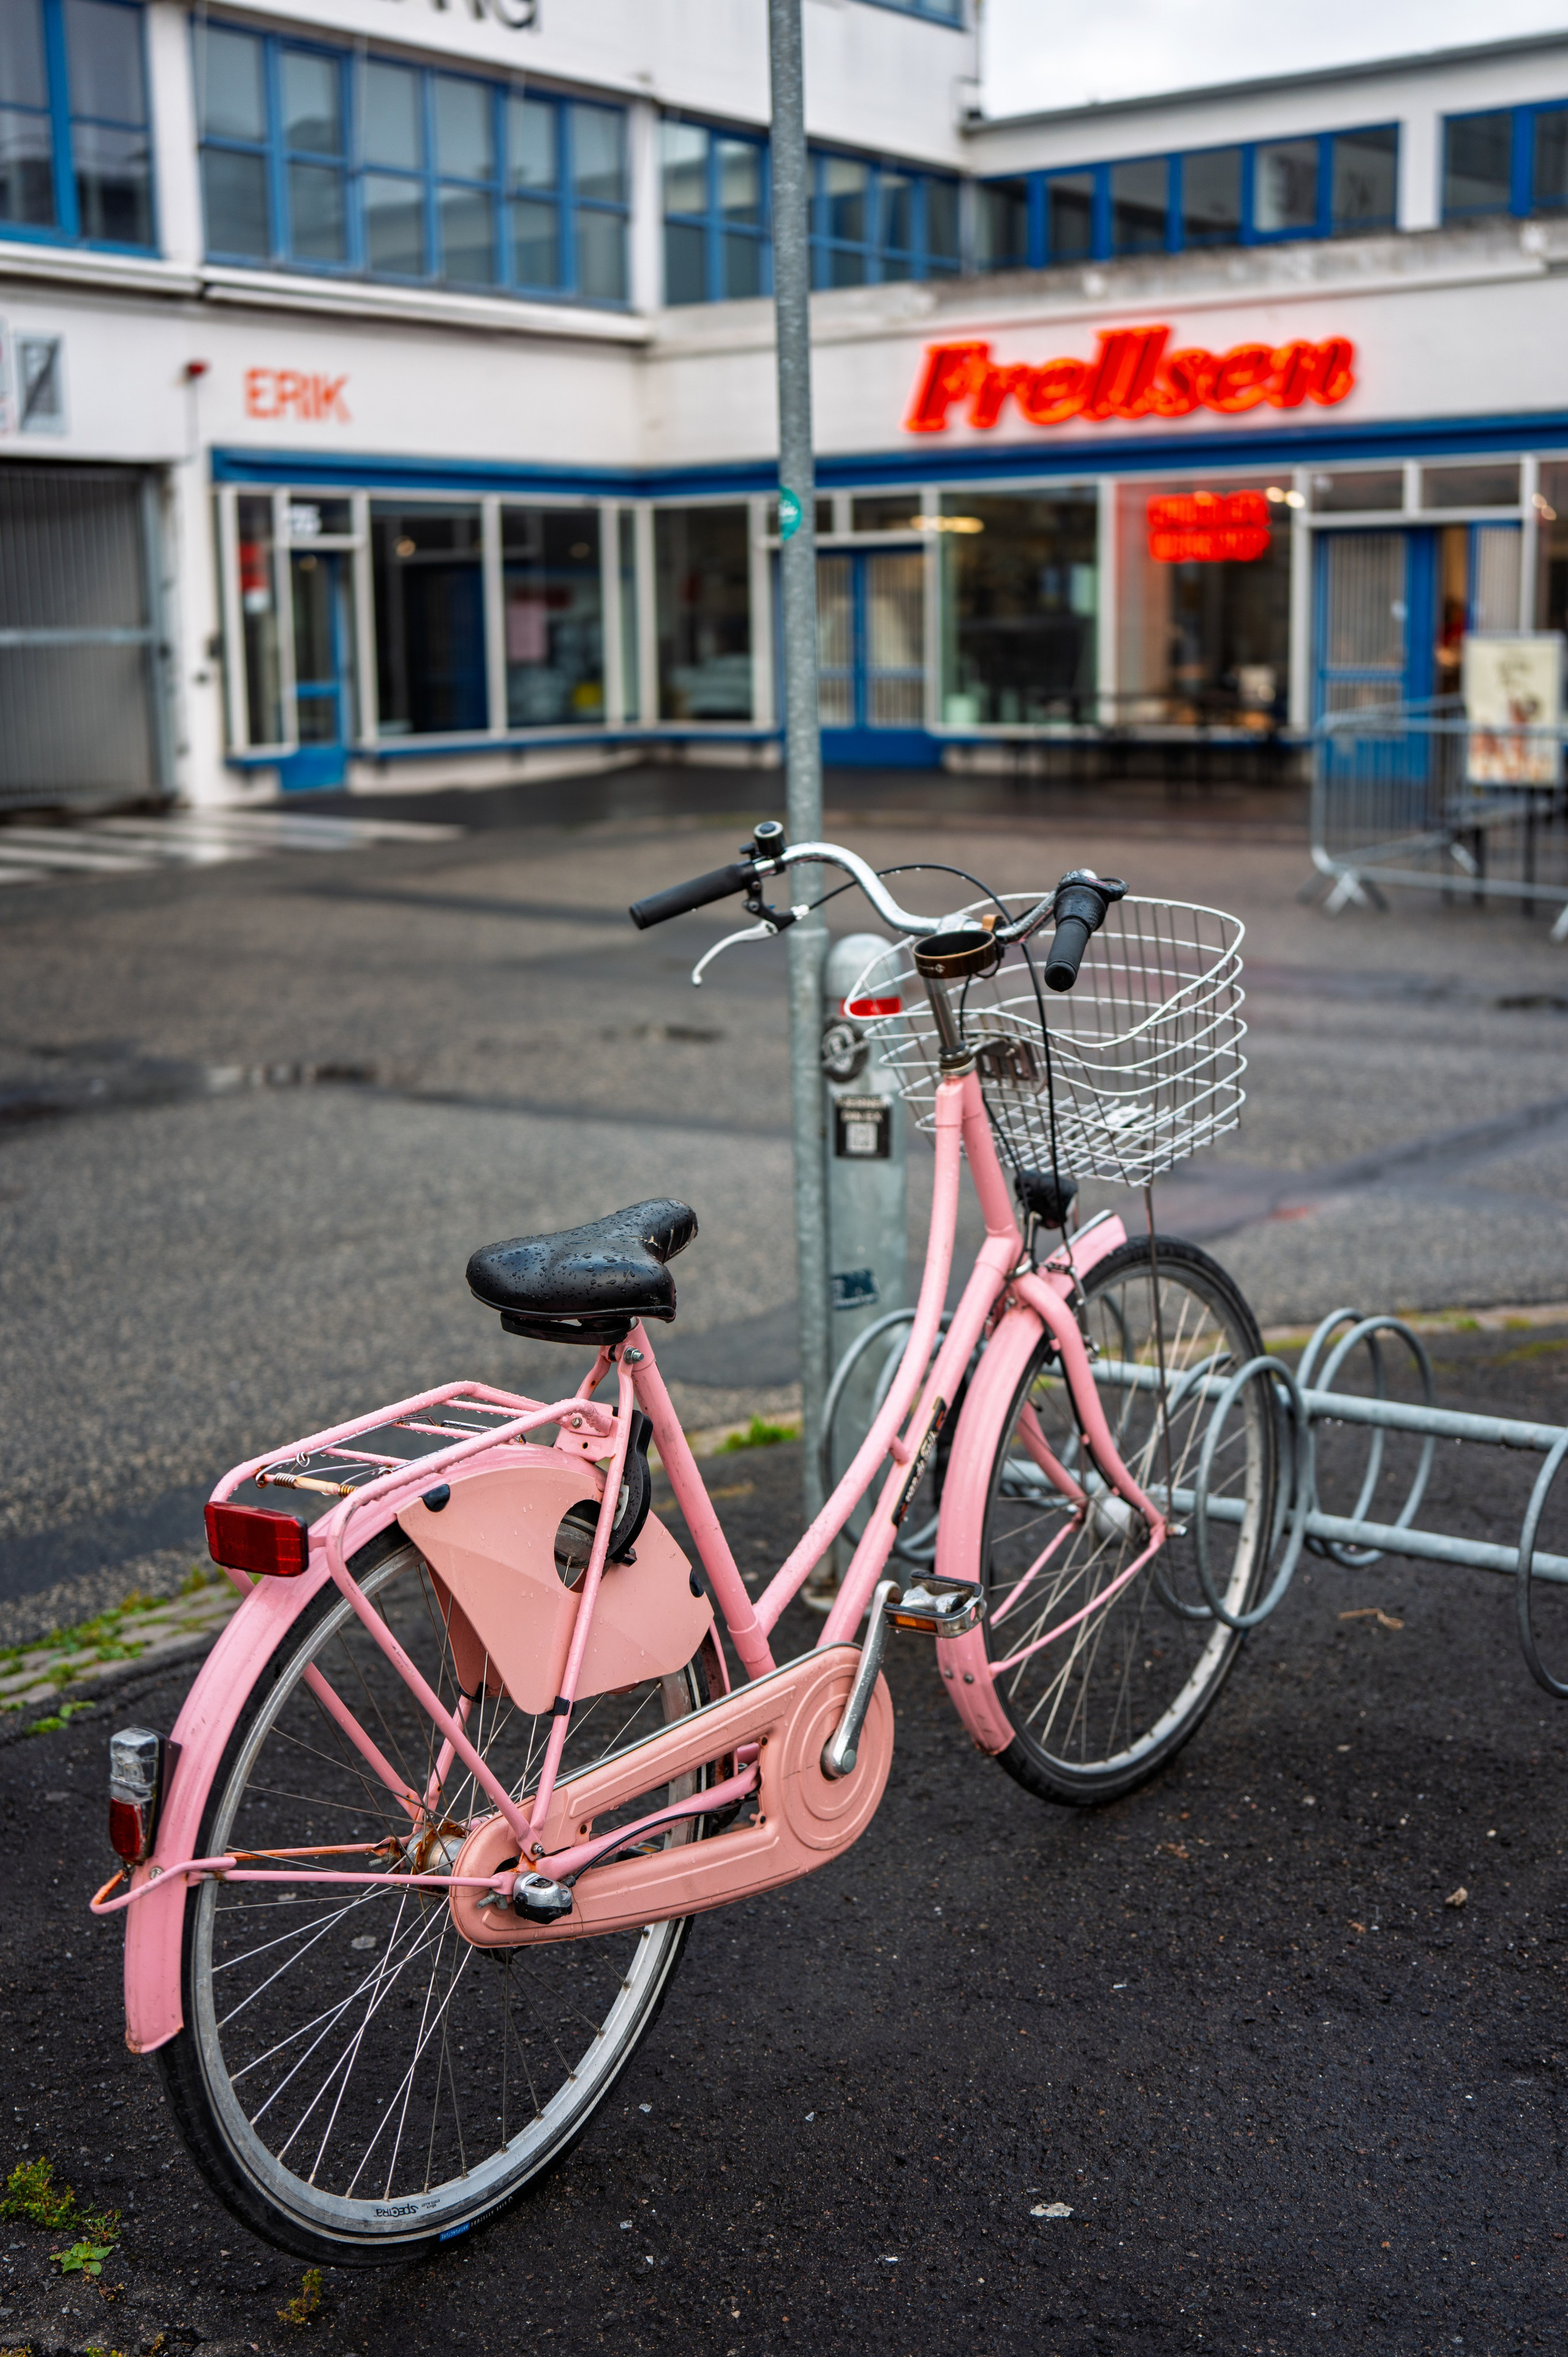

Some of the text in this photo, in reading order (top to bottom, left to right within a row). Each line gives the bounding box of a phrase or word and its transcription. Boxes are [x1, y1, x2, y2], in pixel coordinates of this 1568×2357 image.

[244, 366, 353, 426] ERIK
[905, 324, 1354, 432] Frellsen
[470, 2201, 507, 2226] BIKE ATTITUDE
